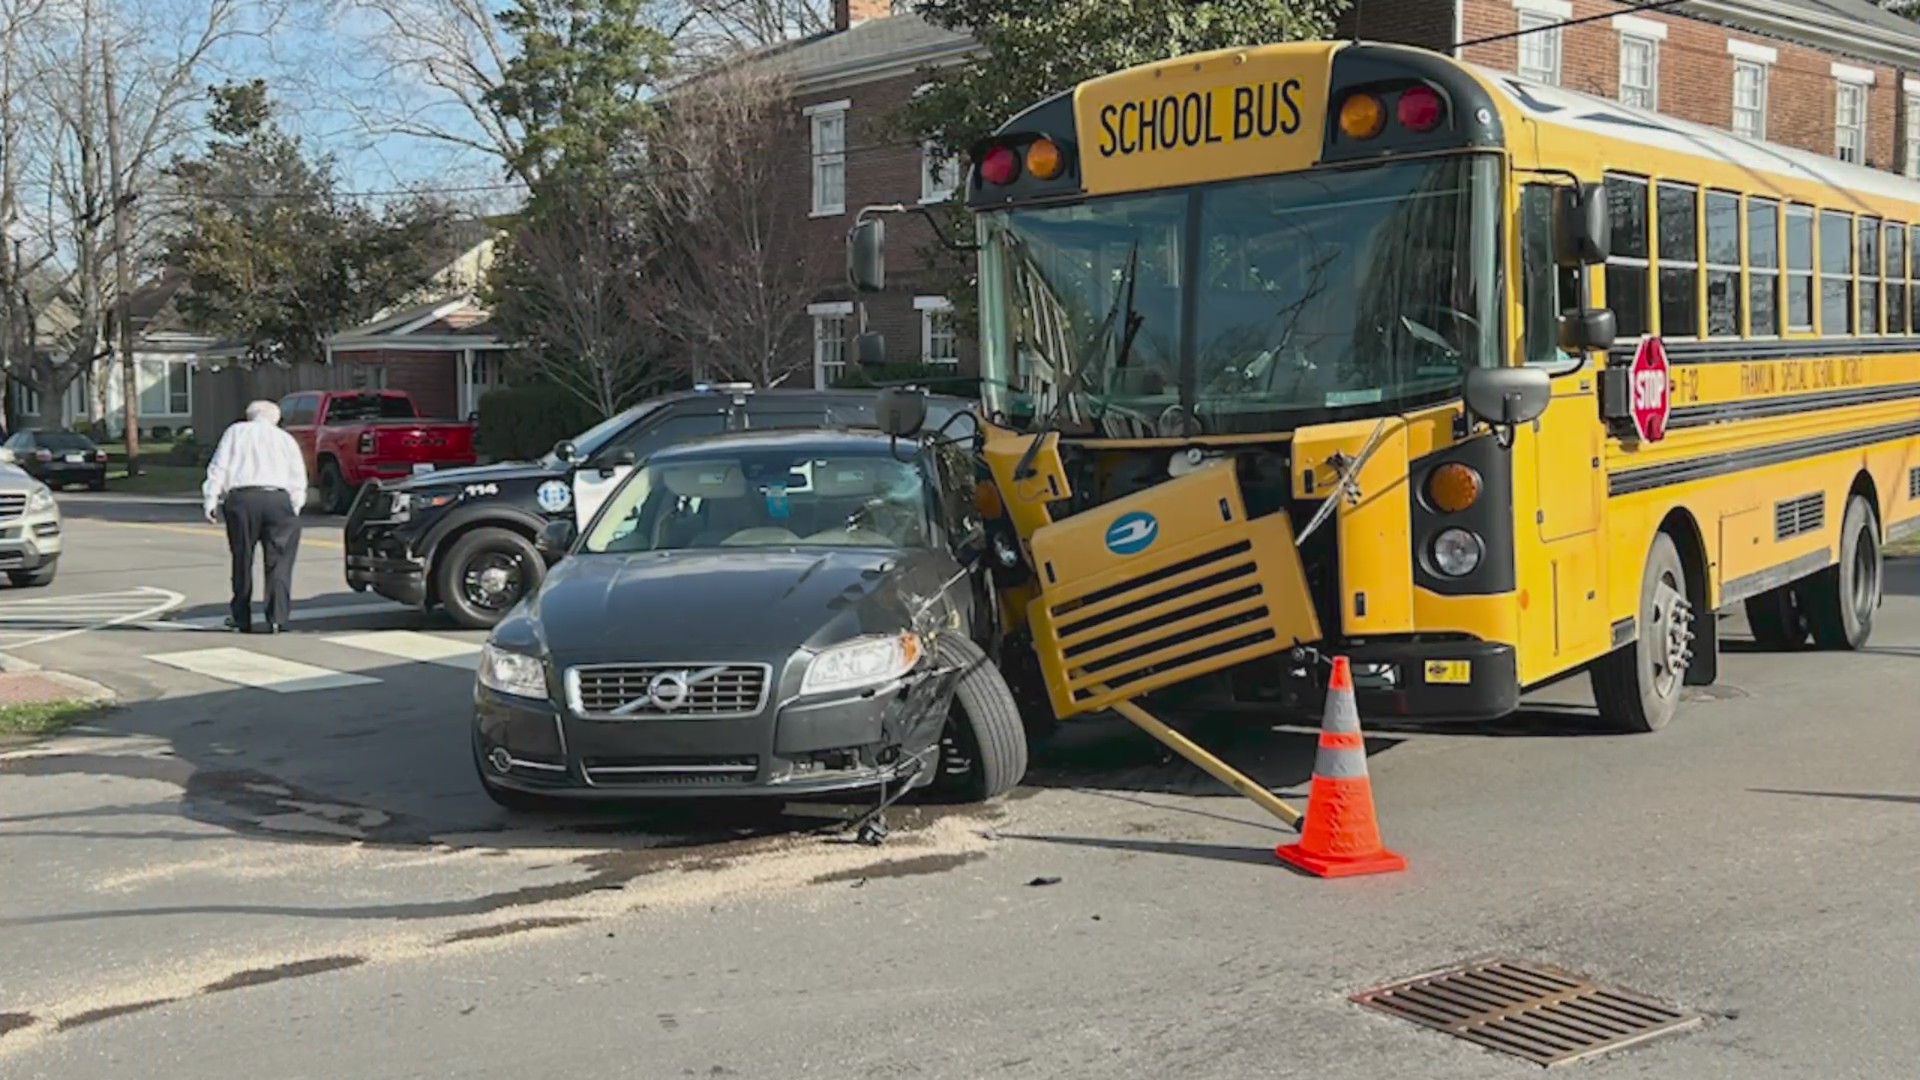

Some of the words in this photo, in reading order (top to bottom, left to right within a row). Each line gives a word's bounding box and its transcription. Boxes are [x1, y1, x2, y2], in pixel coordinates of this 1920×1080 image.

[1099, 92, 1222, 157] SCHOOL
[1233, 78, 1301, 141] BUS
[1635, 369, 1666, 410] STOP
